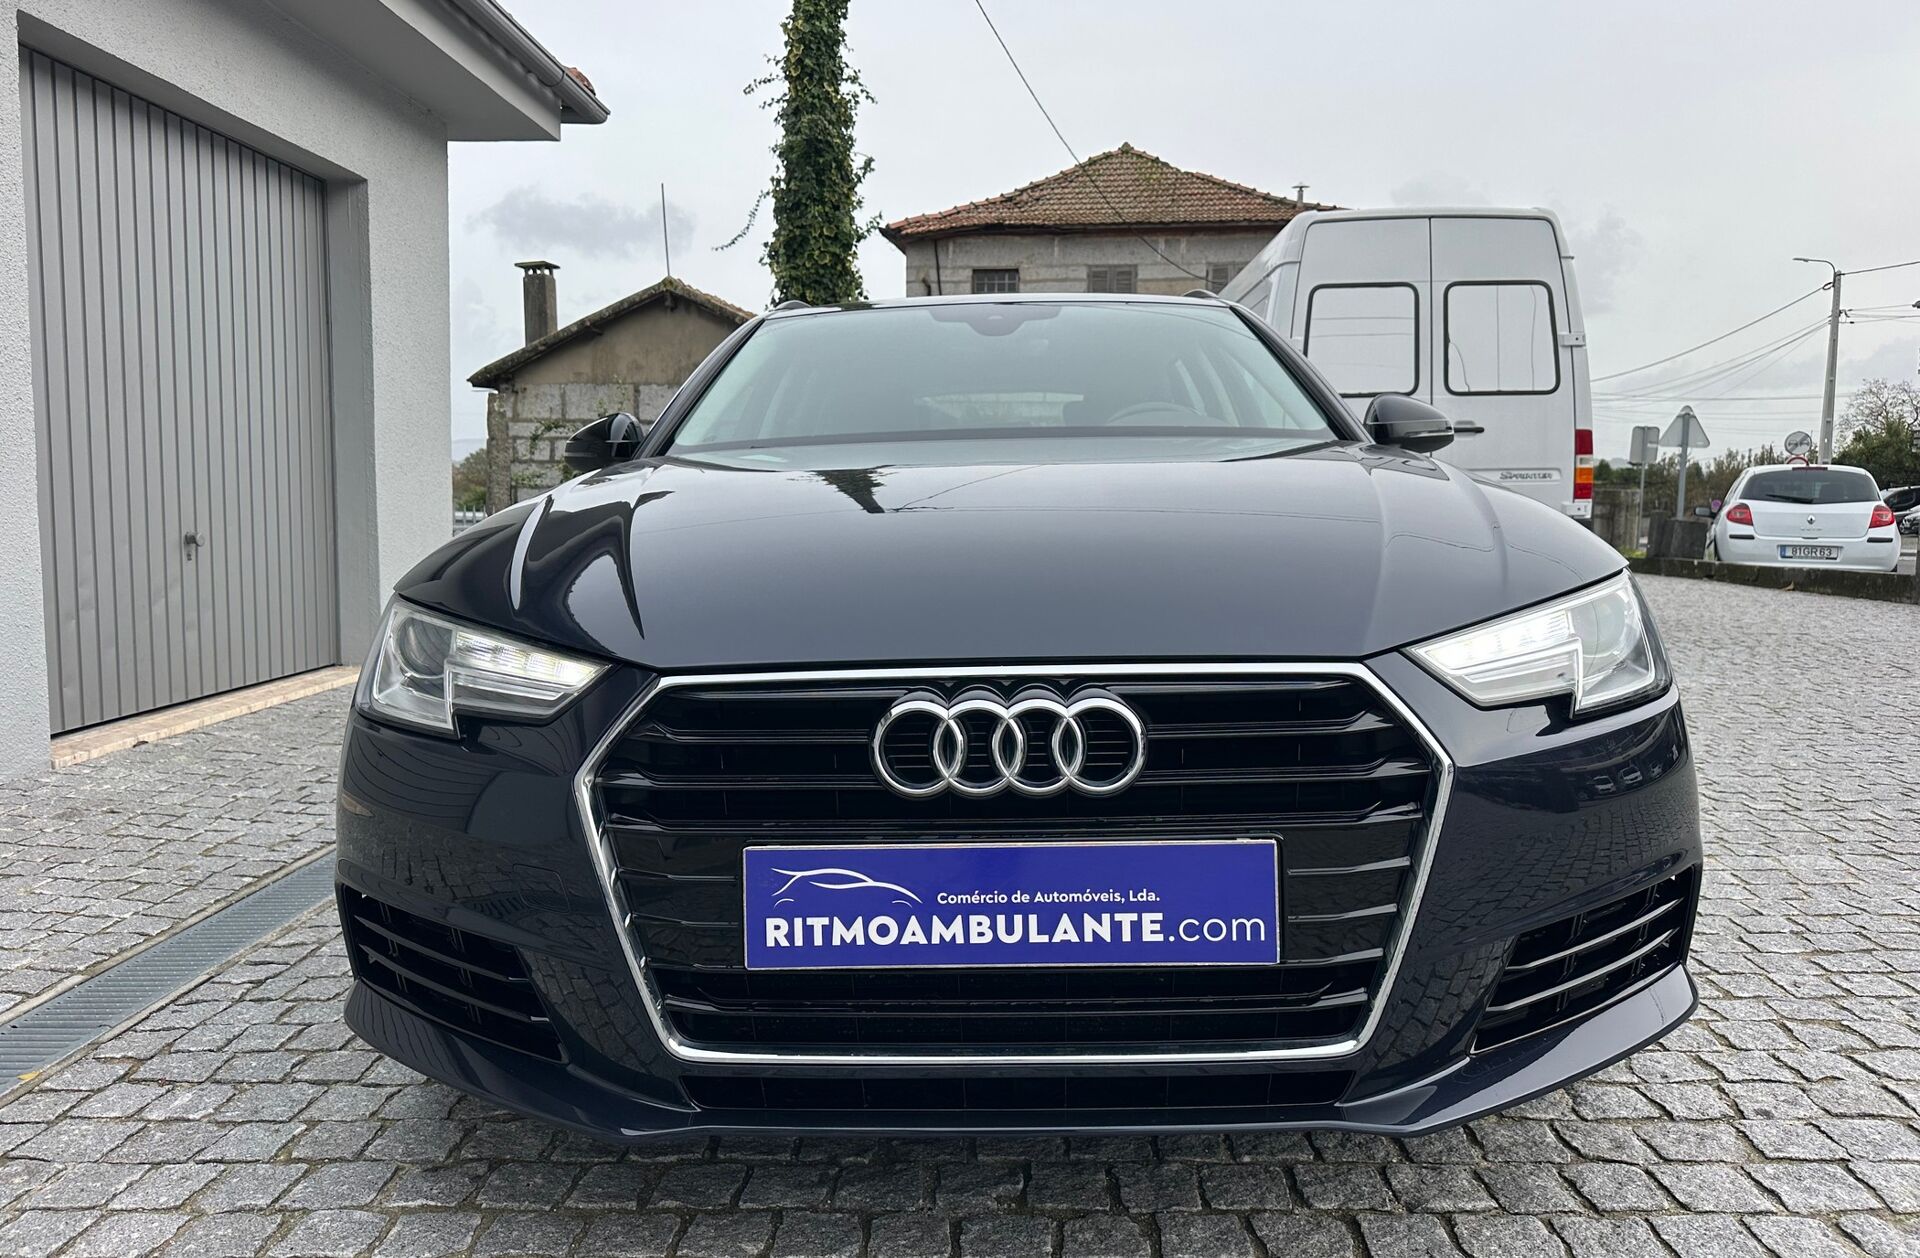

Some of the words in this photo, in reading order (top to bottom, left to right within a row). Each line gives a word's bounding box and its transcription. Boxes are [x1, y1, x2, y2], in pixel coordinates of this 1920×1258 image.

[937, 890, 1008, 904] Comércio
[1011, 890, 1030, 903] de
[1033, 888, 1126, 905] Automóveis,
[1129, 889, 1160, 903] Lda.
[765, 912, 1265, 947] RITMOAMBULANTE.com
